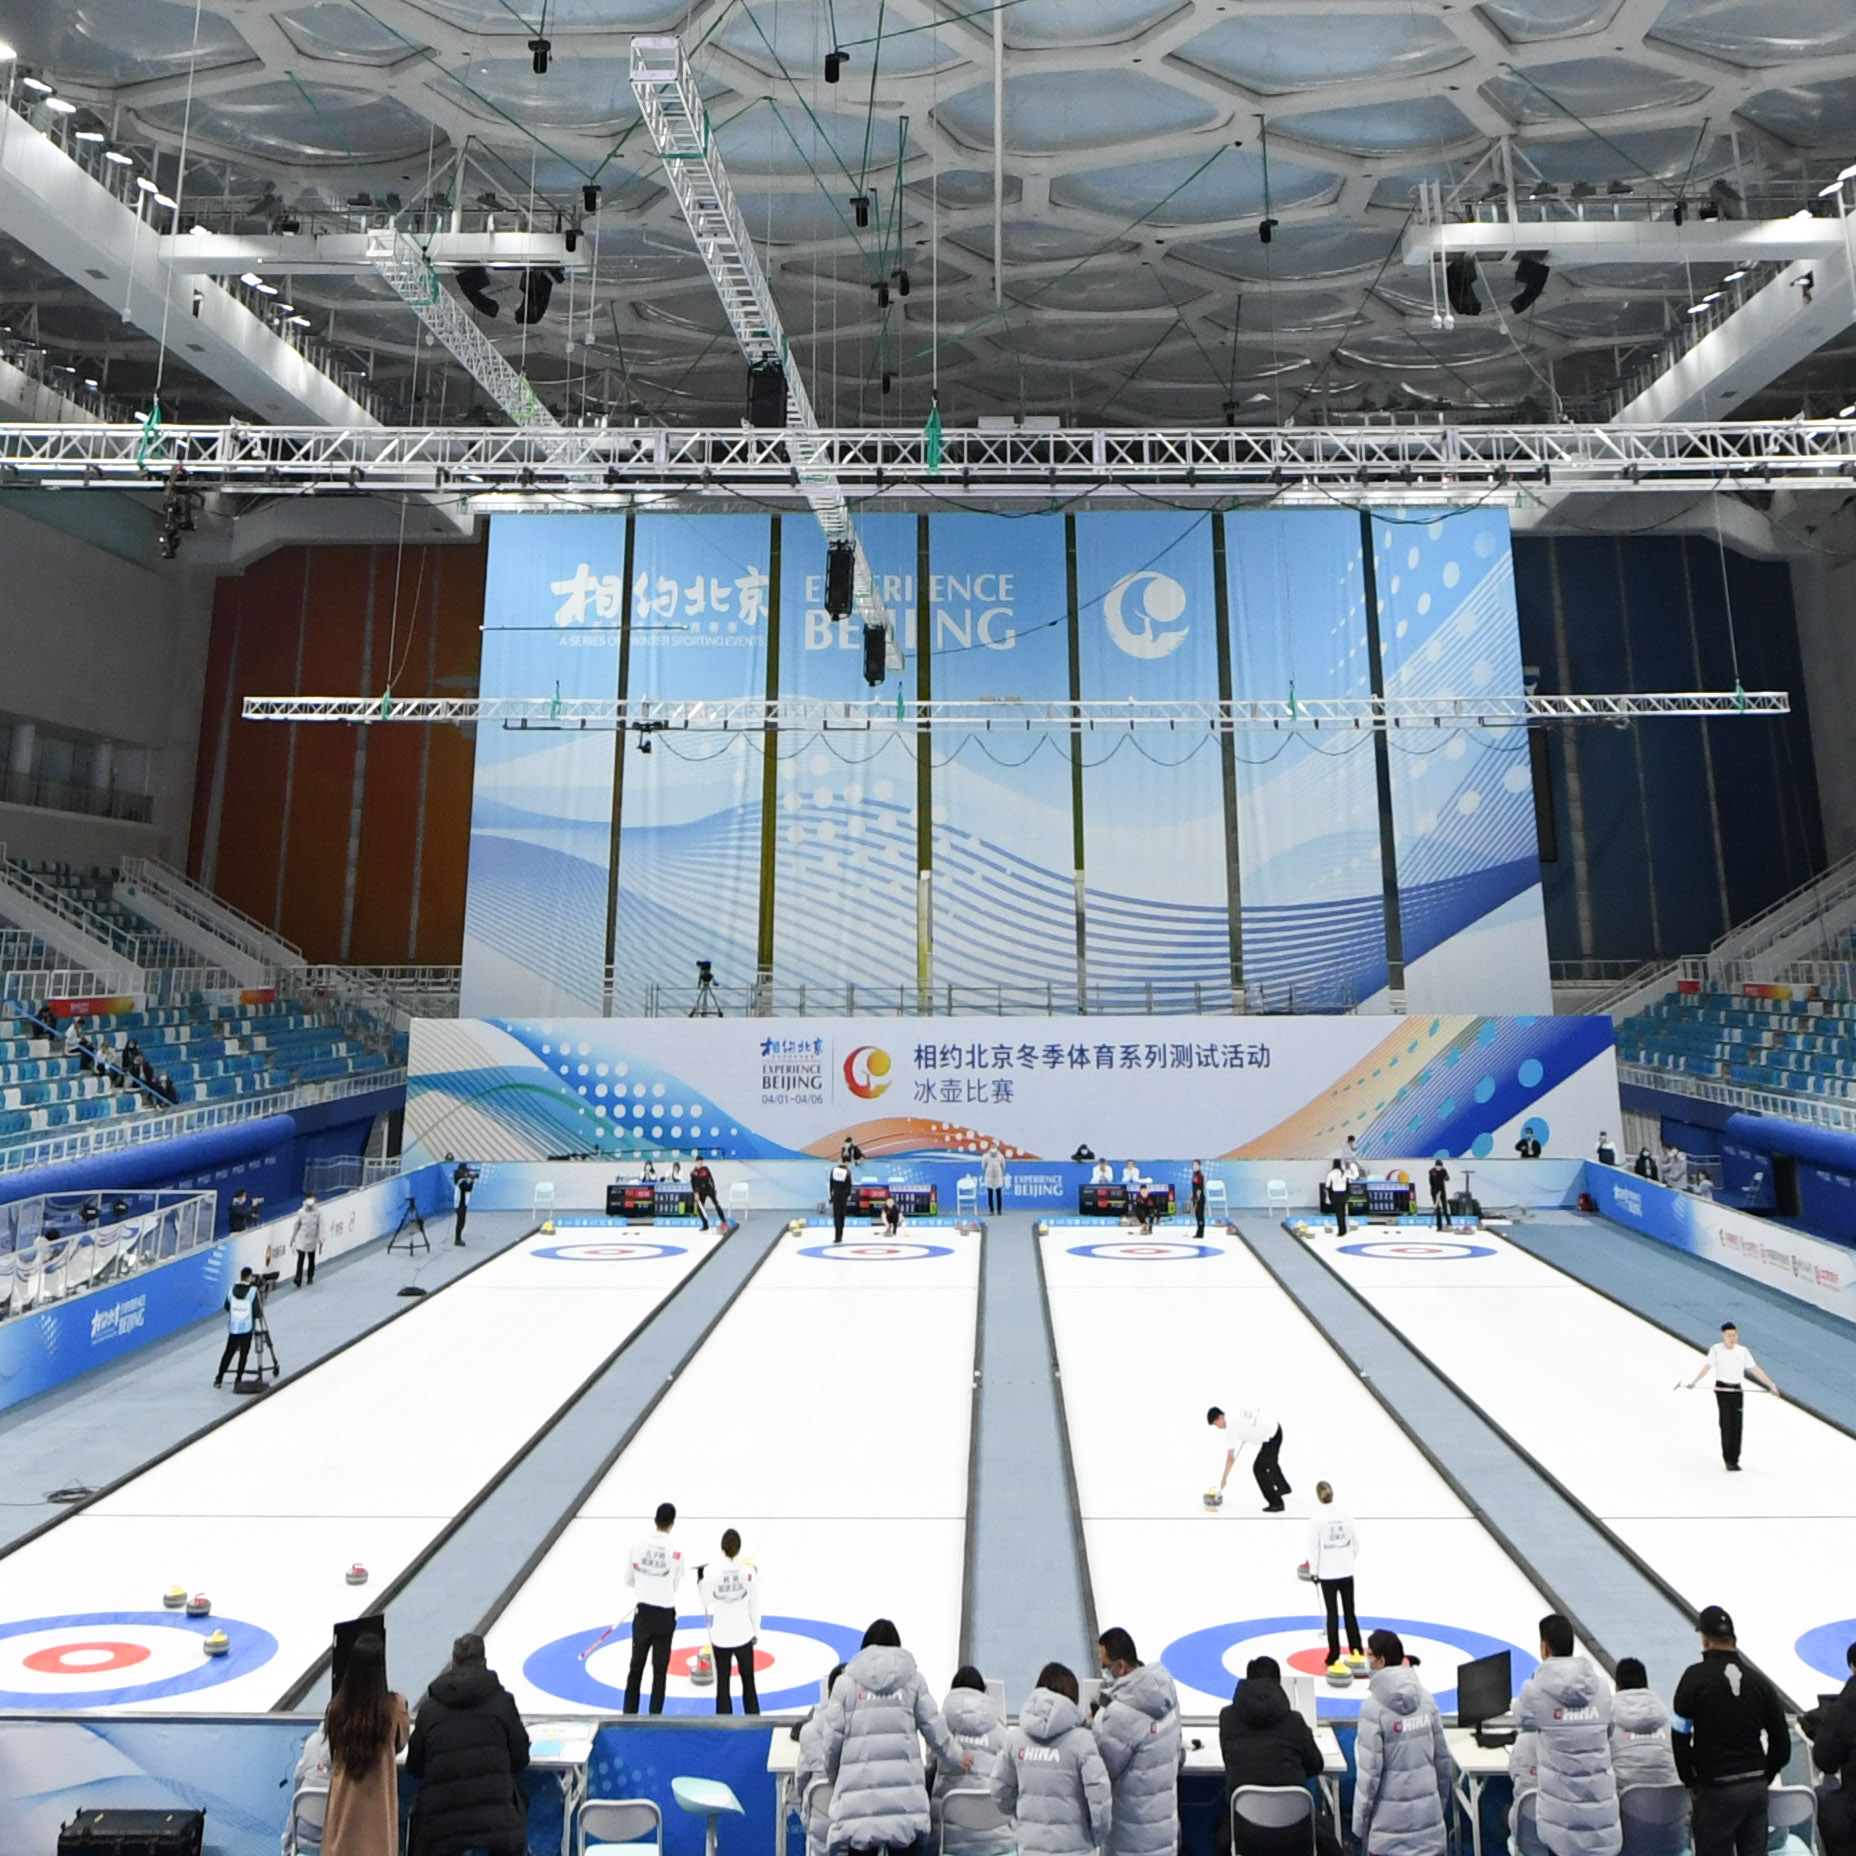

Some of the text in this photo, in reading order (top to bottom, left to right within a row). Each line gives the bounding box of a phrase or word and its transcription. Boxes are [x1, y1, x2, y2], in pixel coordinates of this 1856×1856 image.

[551, 563, 770, 626] 相约北京
[805, 575, 1014, 602] ERIENCE
[804, 607, 1017, 650] BEING
[760, 1037, 824, 1057] 相约北京
[913, 1044, 1271, 1070] 相约北京冬季体育系列测试活动
[762, 1064, 822, 1075] EXPERIENCE
[762, 1075, 823, 1091] BEIJING
[912, 1078, 1015, 1104] 冰壶比赛
[1013, 1184, 1064, 1197] BEIJING
[1552, 1706, 1600, 1723] CHINA
[1393, 1715, 1432, 1735] CHINA
[1017, 1746, 1061, 1764] CHINA
